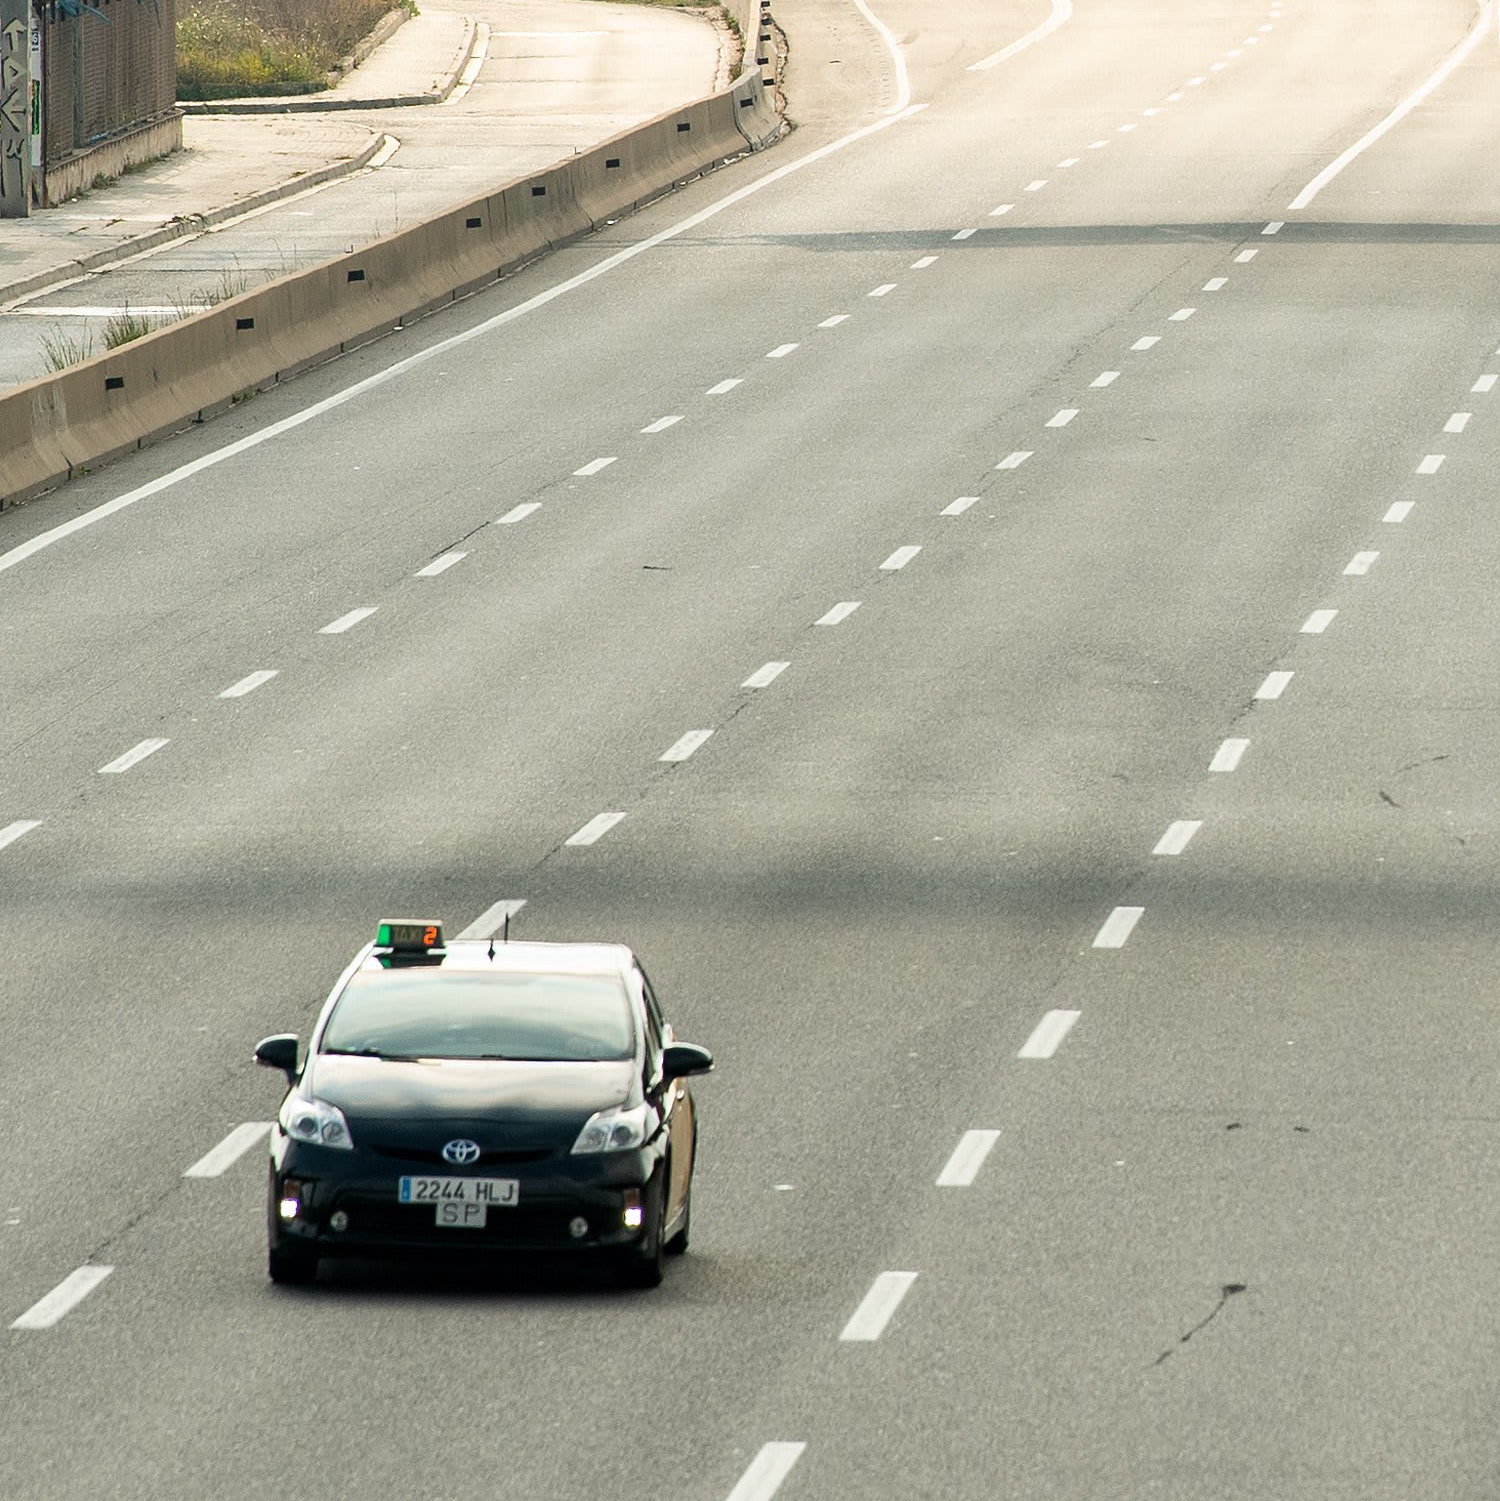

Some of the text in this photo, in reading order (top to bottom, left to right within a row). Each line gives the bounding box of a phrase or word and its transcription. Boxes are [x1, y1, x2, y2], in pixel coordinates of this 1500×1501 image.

[415, 1180, 514, 1203] 2244 HLJ
[442, 1202, 481, 1223] SP
